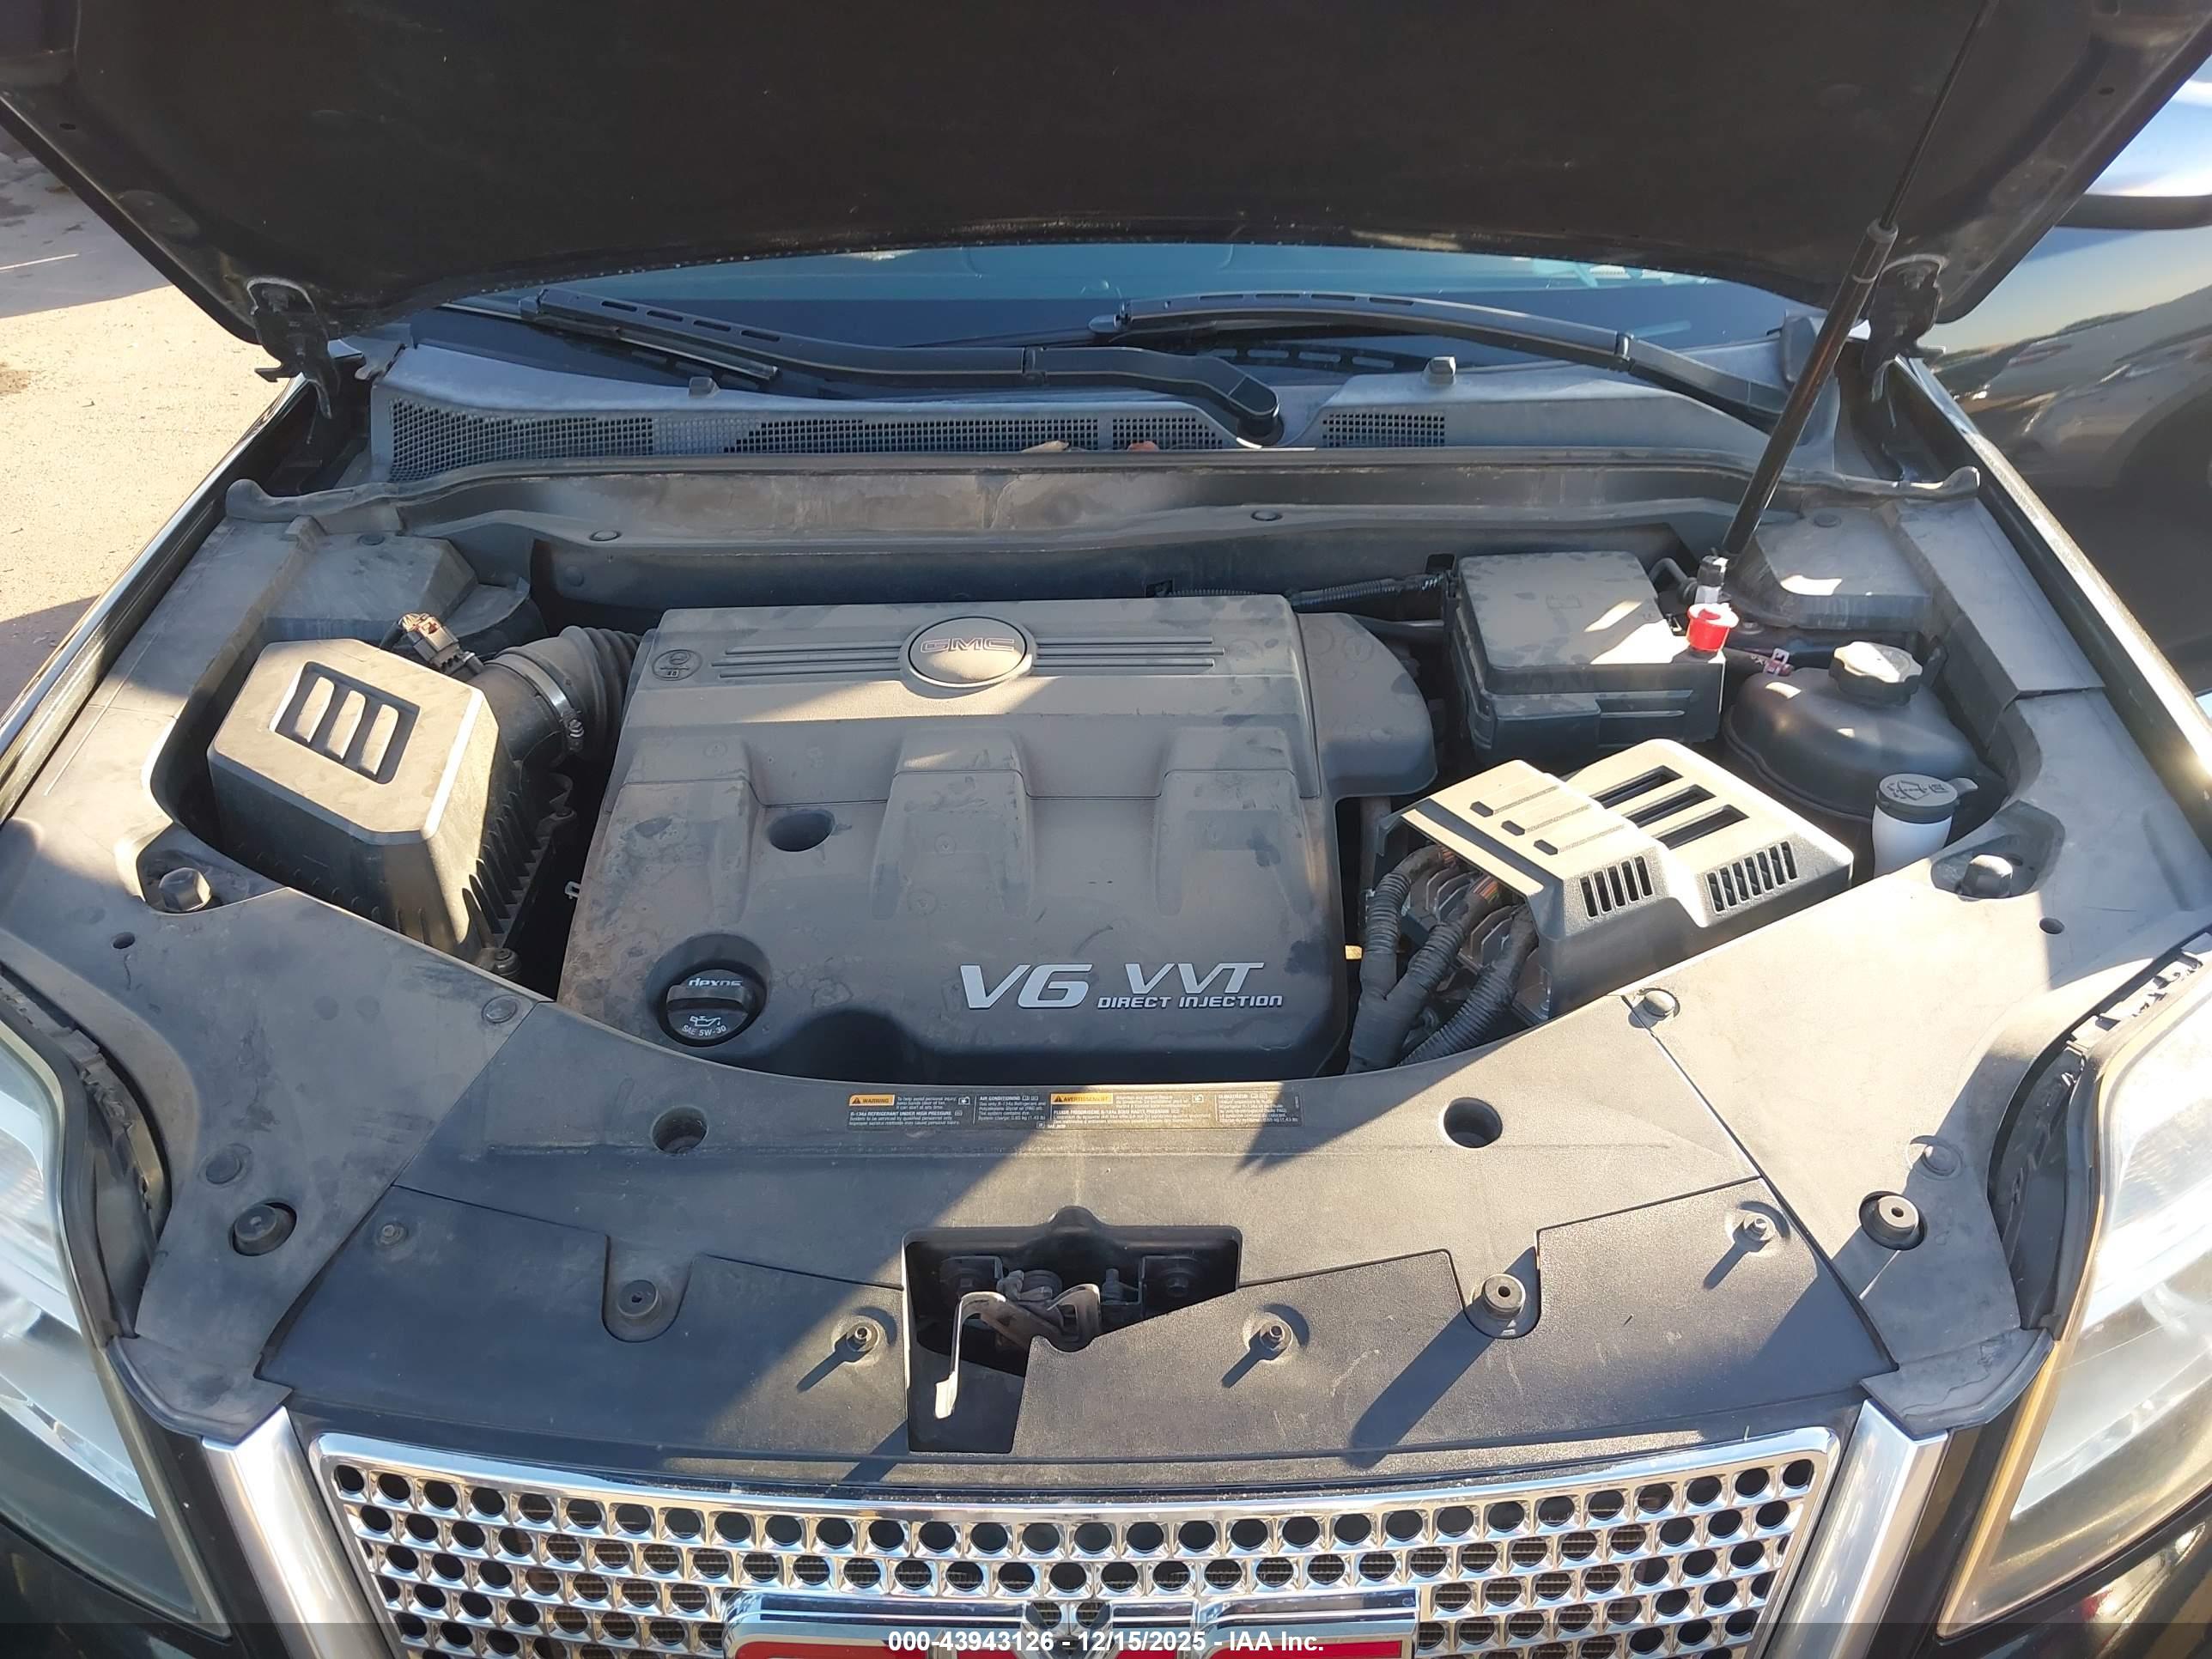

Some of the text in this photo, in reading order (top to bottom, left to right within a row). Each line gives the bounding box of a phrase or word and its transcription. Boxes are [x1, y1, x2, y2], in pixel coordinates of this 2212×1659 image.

[921, 637, 1014, 653] GMC
[959, 962, 1265, 1010] V6 VVT
[1097, 994, 1283, 1009] DIRECT INJECTION
[682, 1024, 726, 1036] SAE 5W-30
